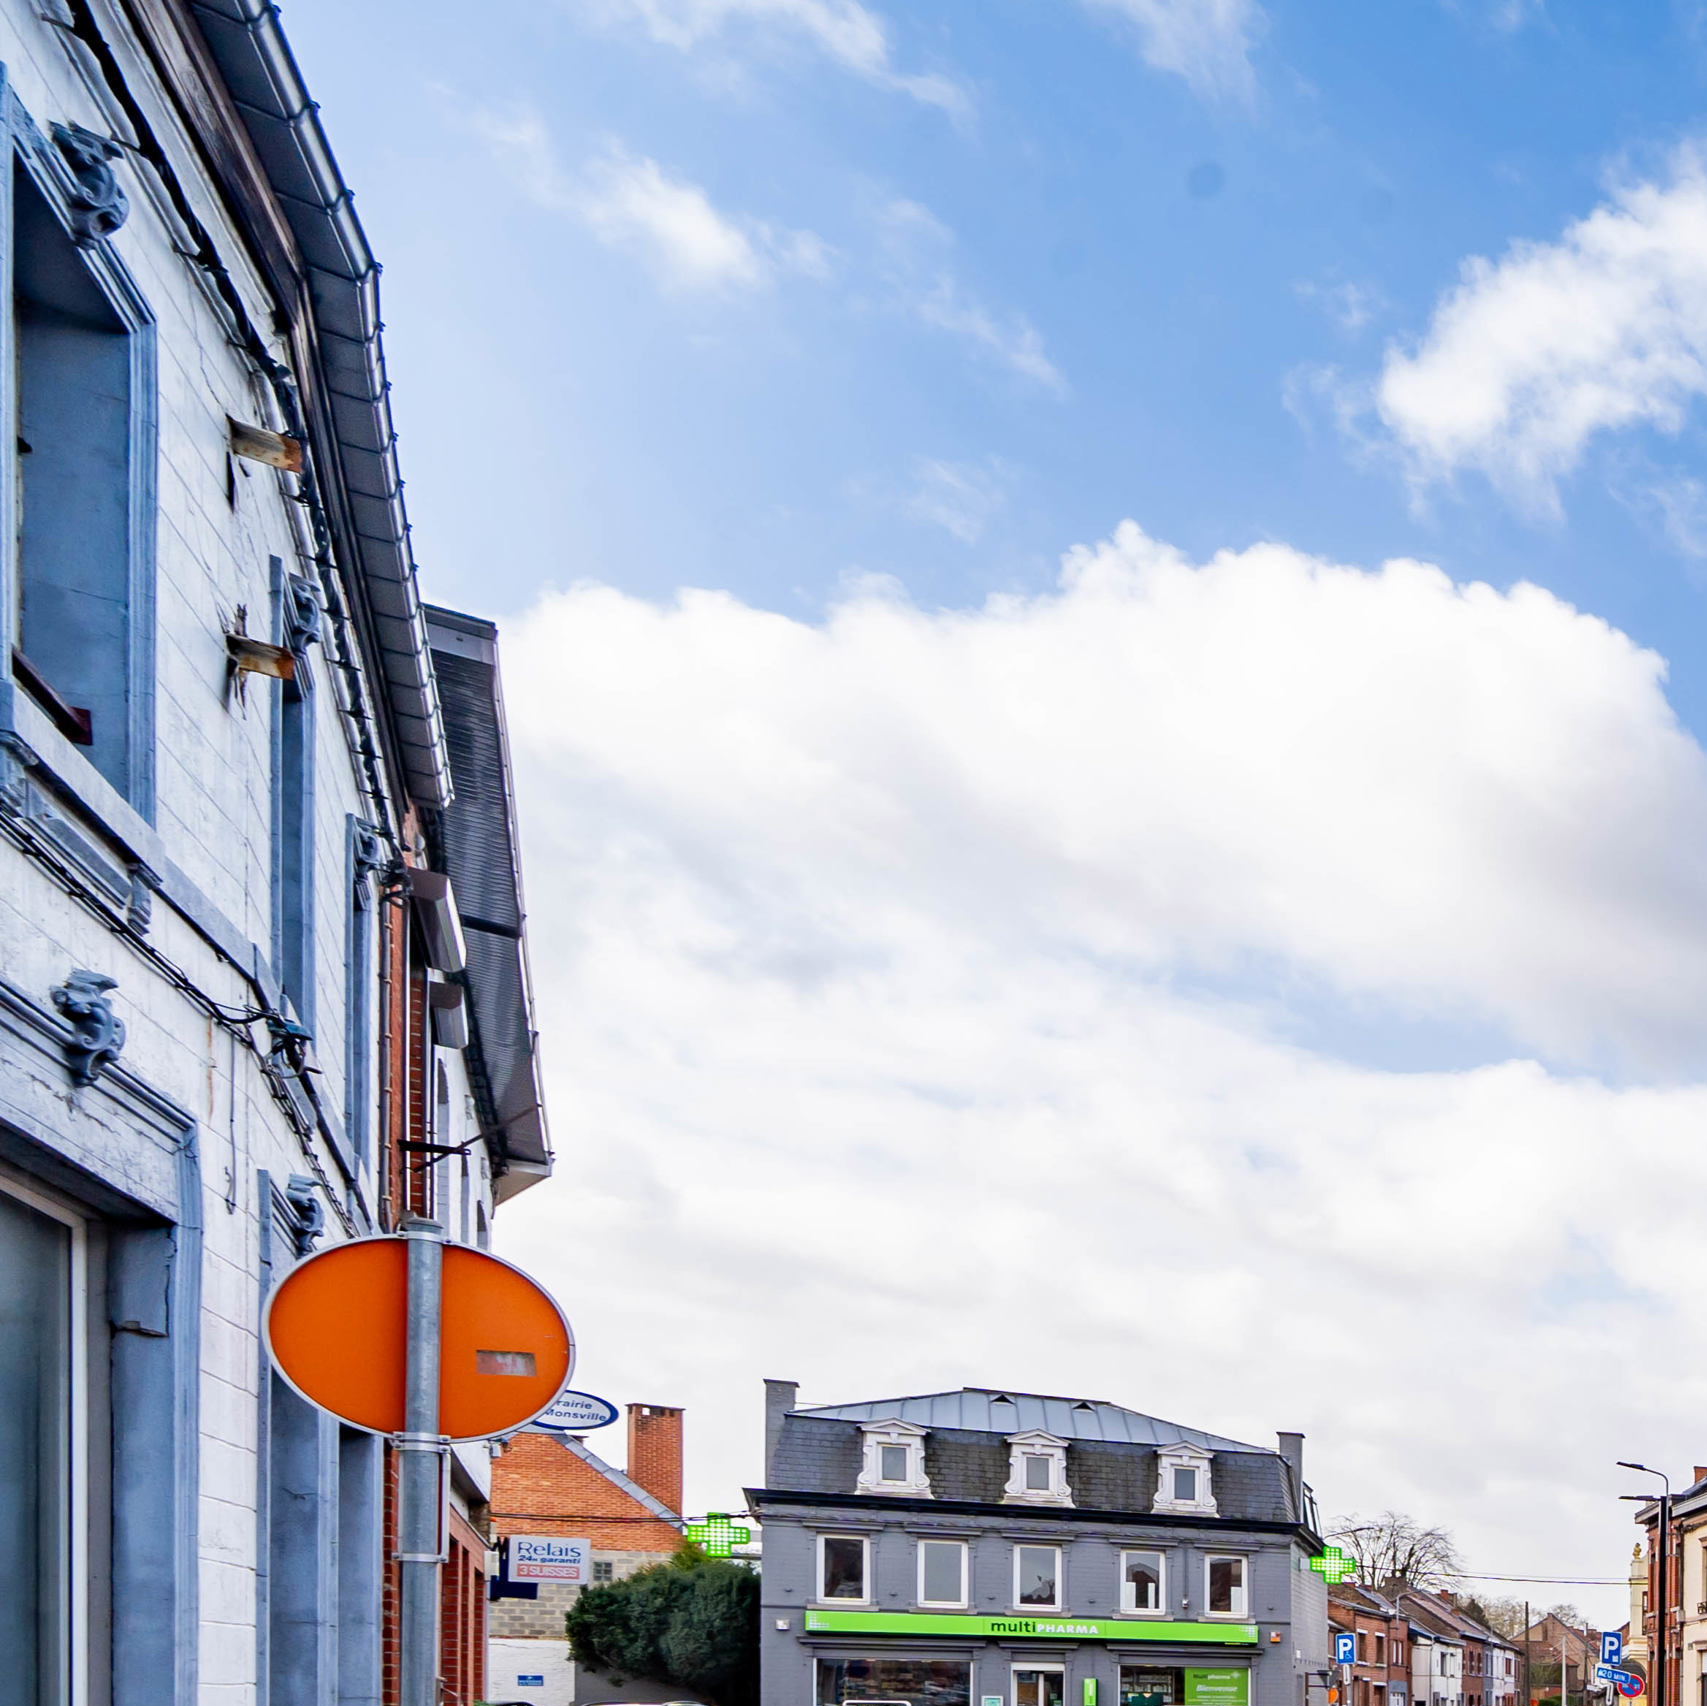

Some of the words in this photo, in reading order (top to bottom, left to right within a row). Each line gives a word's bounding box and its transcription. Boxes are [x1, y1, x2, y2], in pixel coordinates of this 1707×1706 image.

[556, 1400, 593, 1410] rairie
[518, 1541, 582, 1558] Relais
[540, 1556, 581, 1565] garanti
[519, 1565, 529, 1576] 3
[529, 1566, 577, 1577] SUISSES
[1339, 1638, 1353, 1660] P
[1604, 1636, 1619, 1659] P
